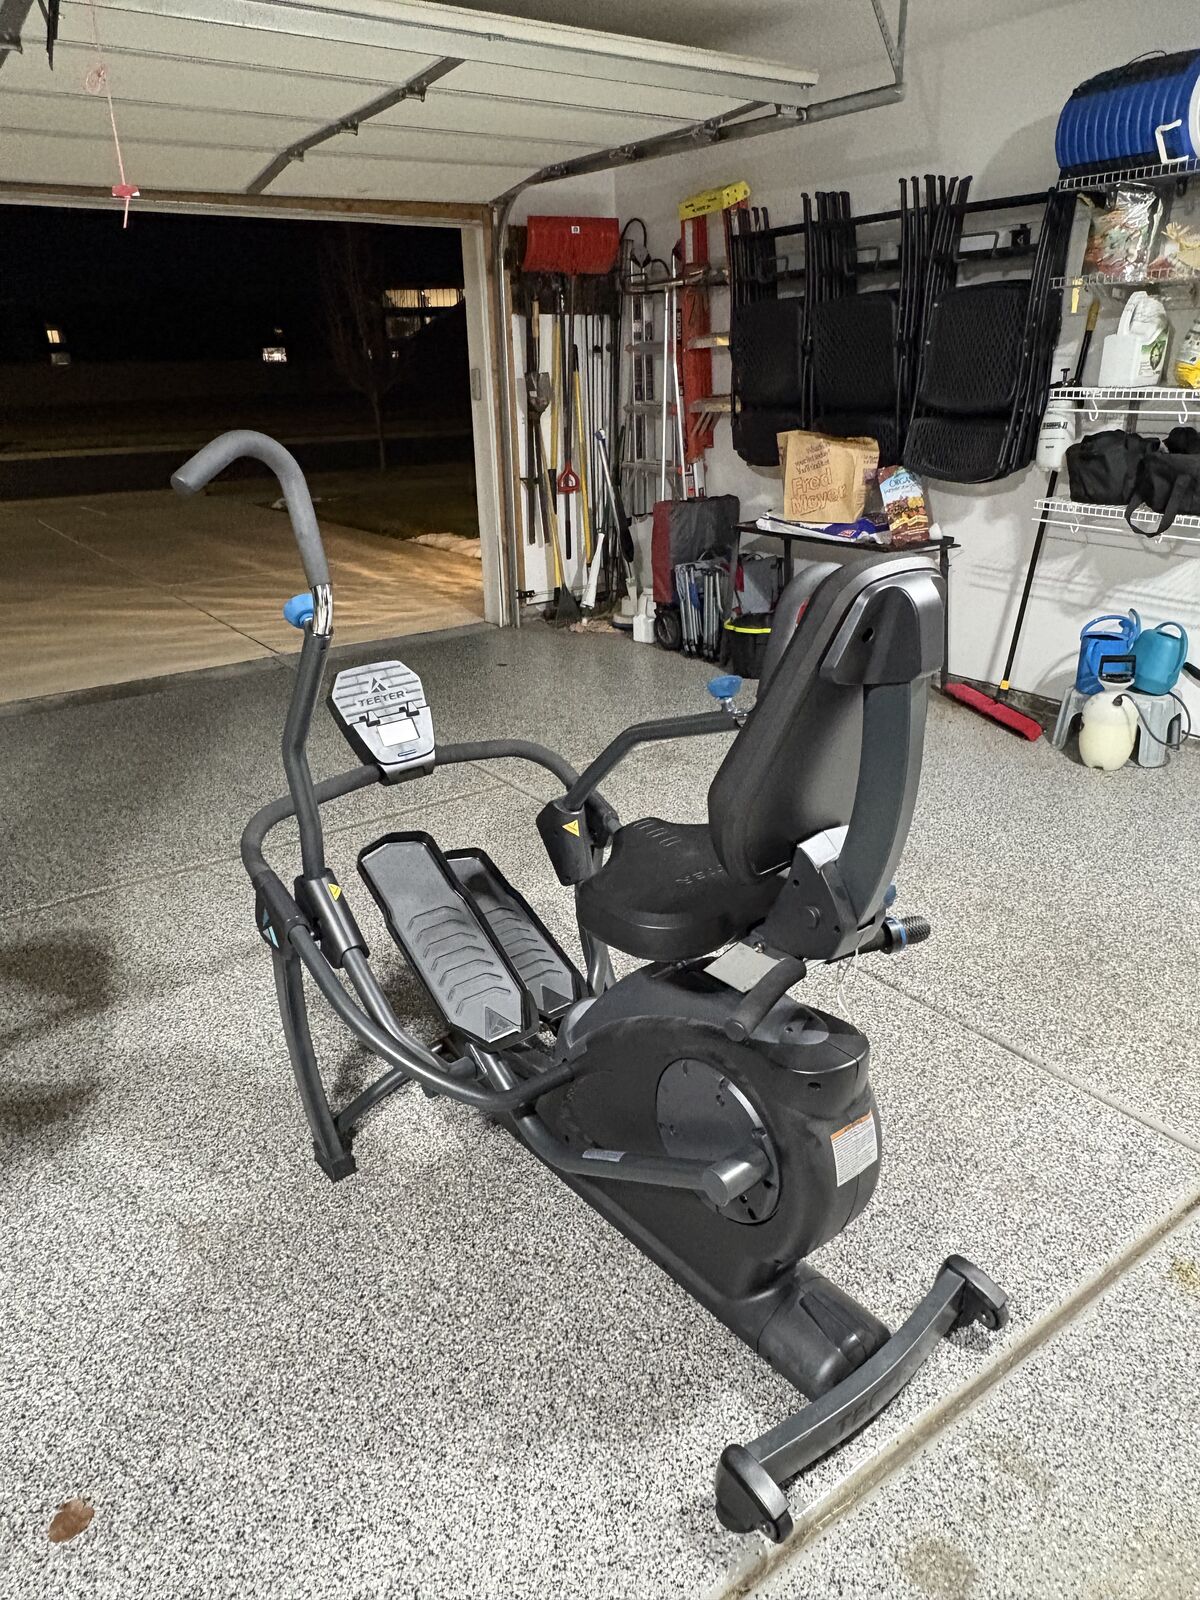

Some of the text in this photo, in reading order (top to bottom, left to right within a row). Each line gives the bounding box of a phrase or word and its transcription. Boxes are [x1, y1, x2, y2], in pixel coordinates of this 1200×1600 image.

[792, 467, 832, 497] Fred
[791, 484, 847, 515] Meyer
[358, 690, 405, 707] TEETER
